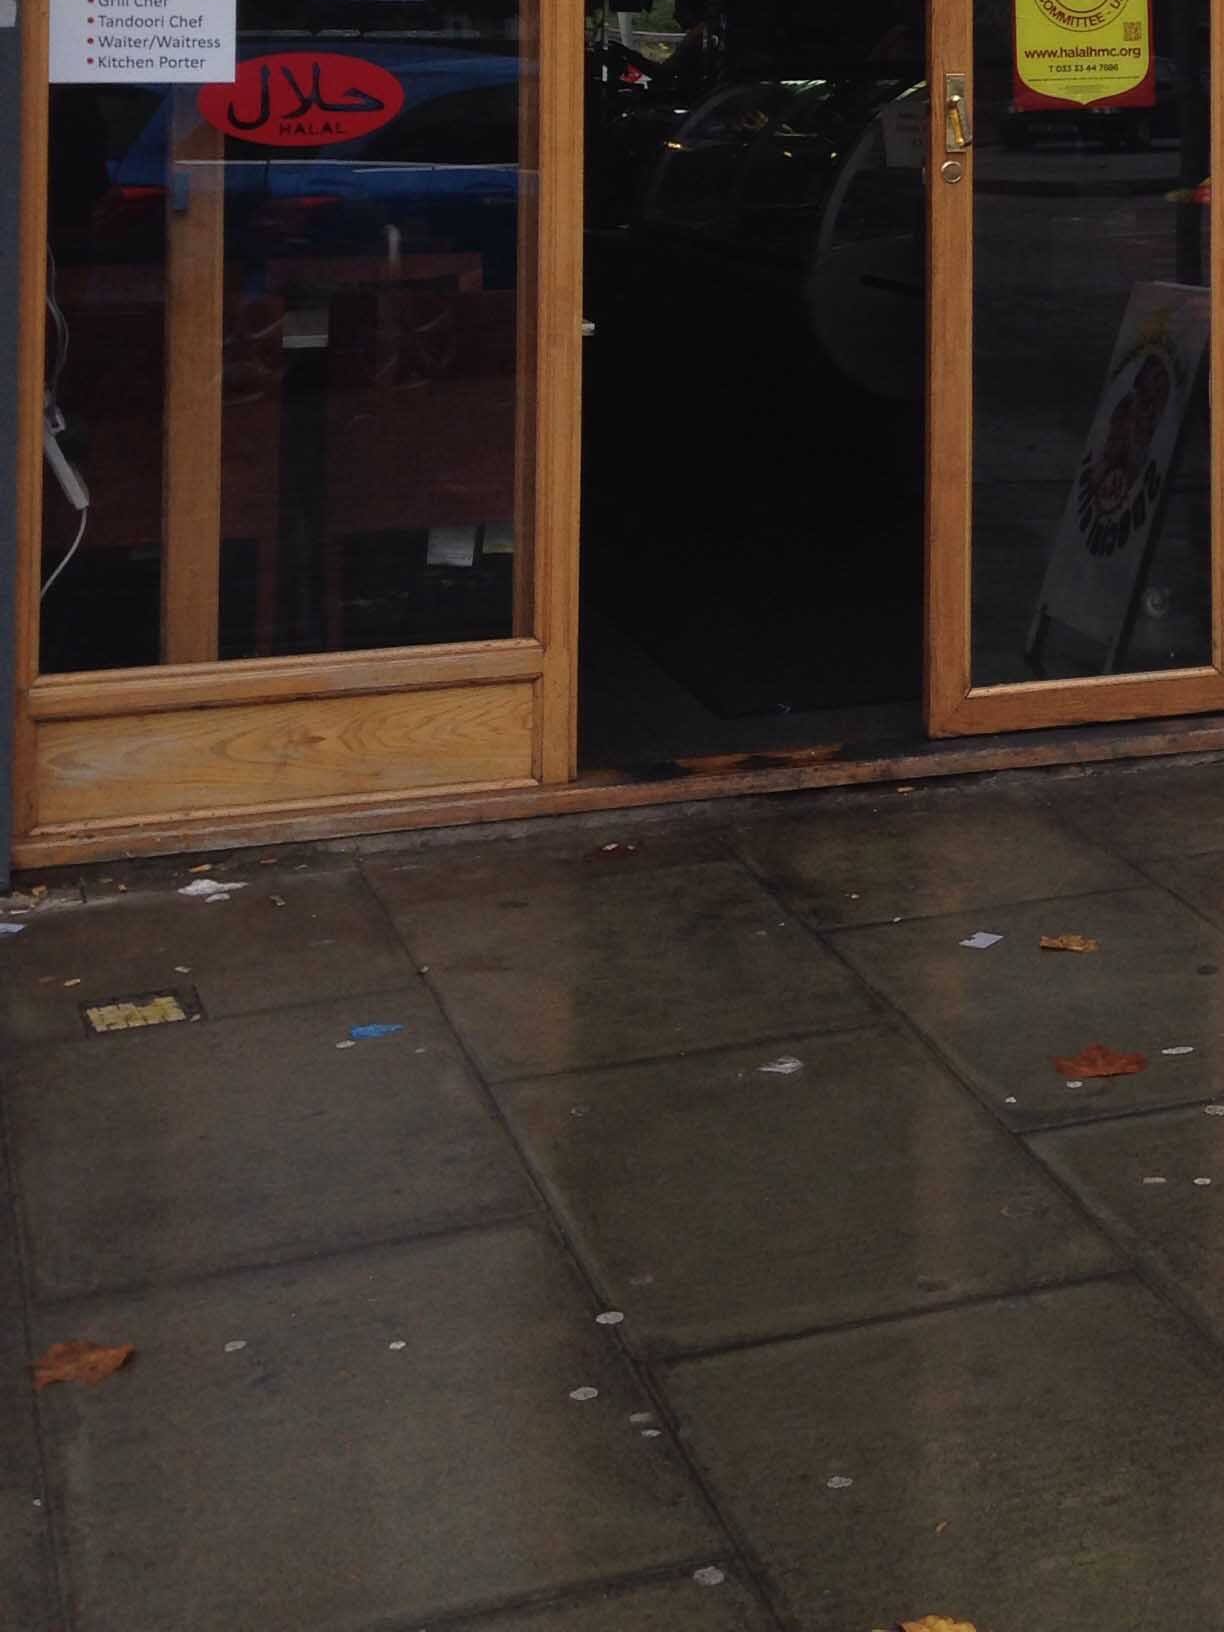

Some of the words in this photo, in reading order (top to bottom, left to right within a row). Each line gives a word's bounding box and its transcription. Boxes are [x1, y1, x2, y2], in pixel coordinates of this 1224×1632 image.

[98, 15, 164, 28] Tandoori
[169, 15, 203, 28] Chef
[98, 35, 221, 50] Waiter/Waitress
[1024, 46, 1142, 59] www.halalhmc.org
[98, 56, 154, 69] Kitchen
[159, 56, 206, 69] Porter
[227, 61, 386, 131] حلال
[279, 122, 347, 137] HALAL
